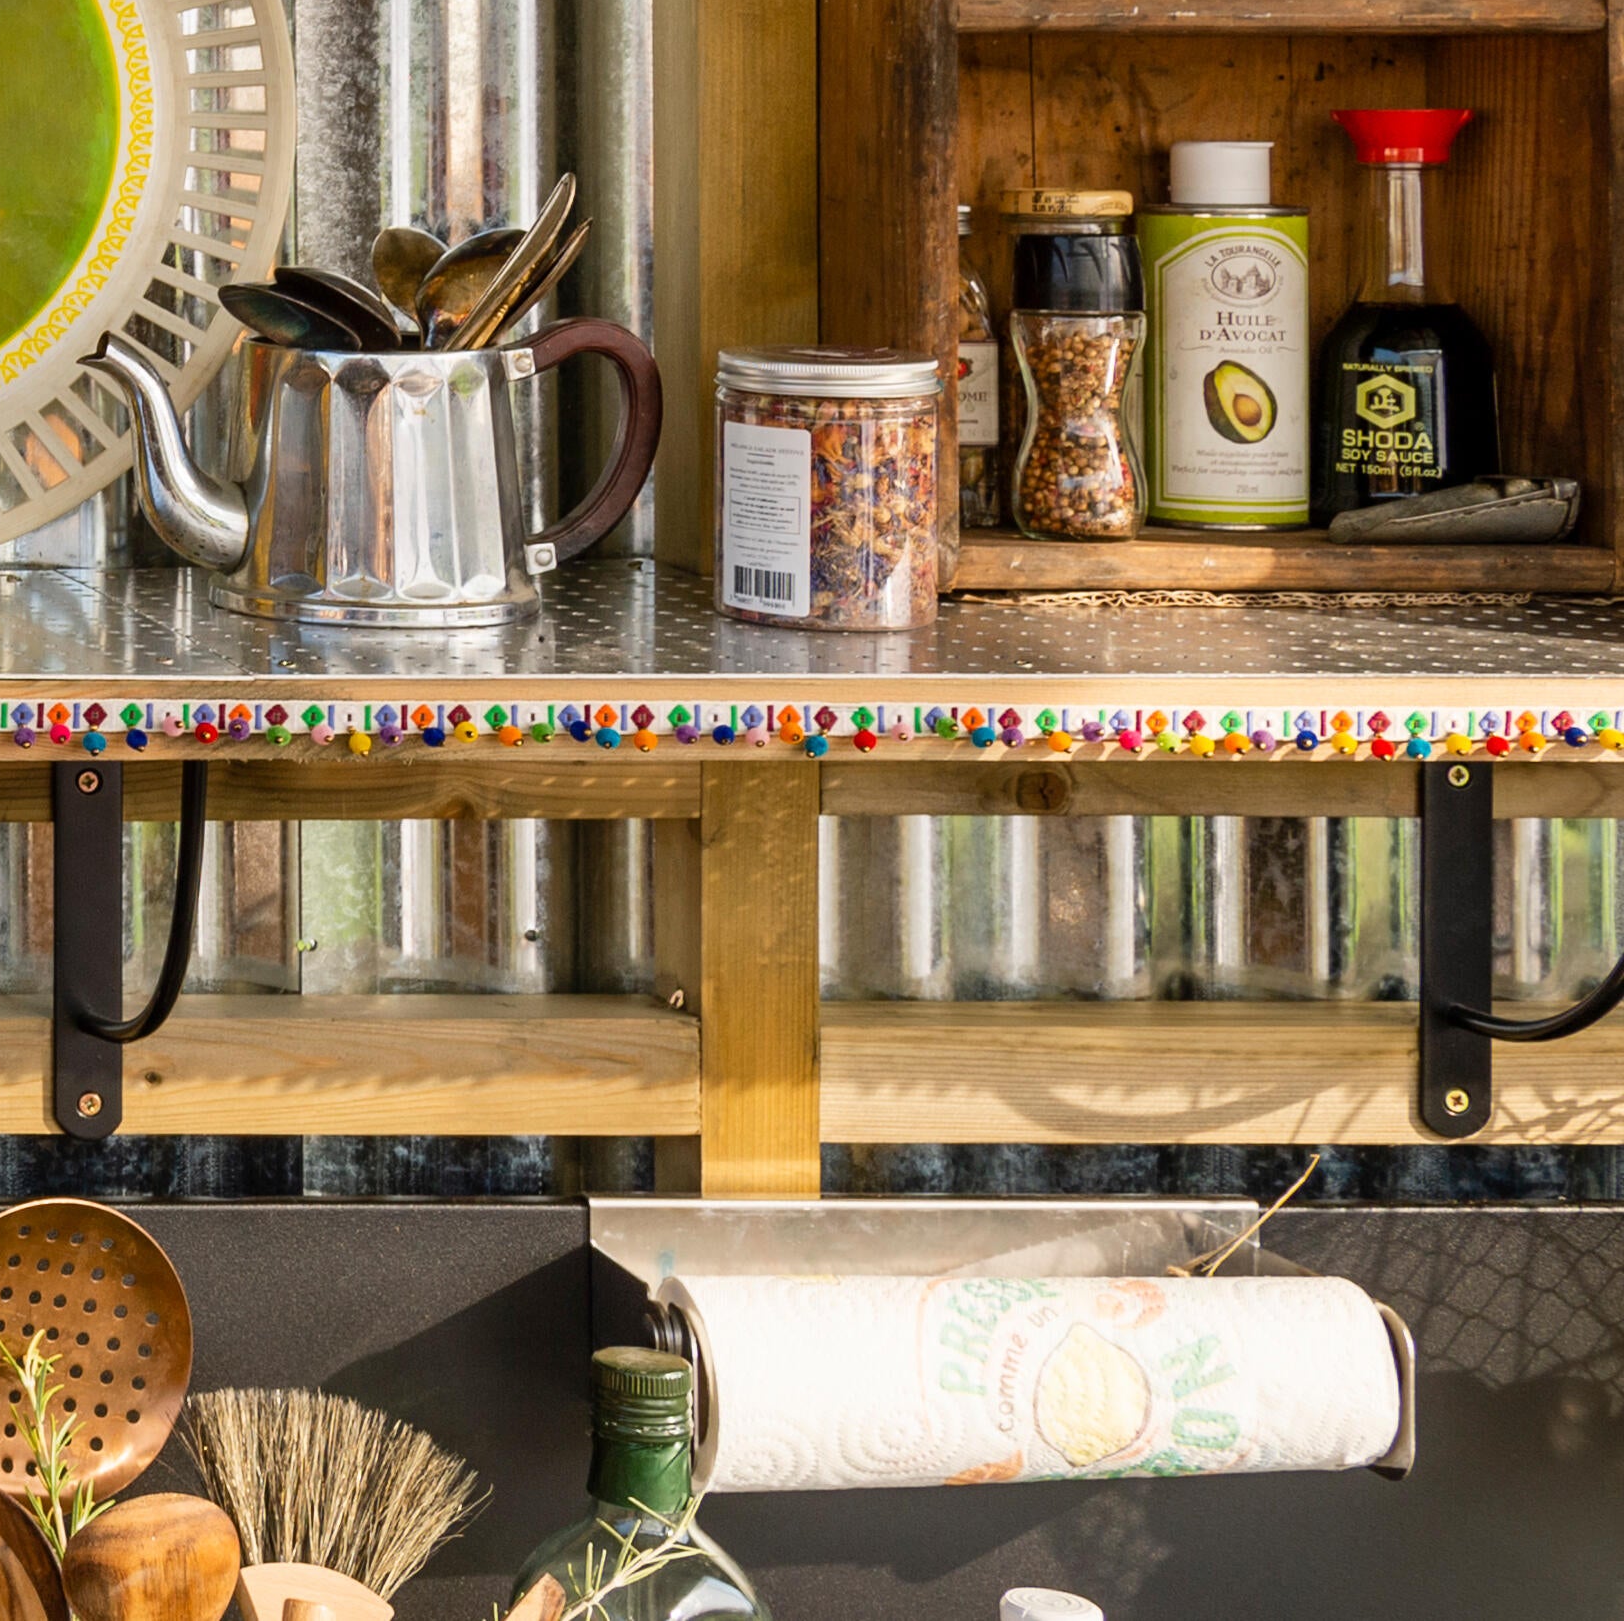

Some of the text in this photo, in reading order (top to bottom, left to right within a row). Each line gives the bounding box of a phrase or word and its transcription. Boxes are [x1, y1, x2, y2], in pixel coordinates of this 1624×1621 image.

[1204, 245, 1282, 268] LA TOURANGELLE
[1342, 362, 1393, 373] NATURALLY
[1342, 428, 1434, 451] SHODA
[1342, 448, 1434, 464] SOY SAUCE
[1335, 462, 1357, 474] NET
[1362, 464, 1396, 476] 150ml
[997, 1333, 1029, 1434] comme
[1027, 1305, 1060, 1328] un
